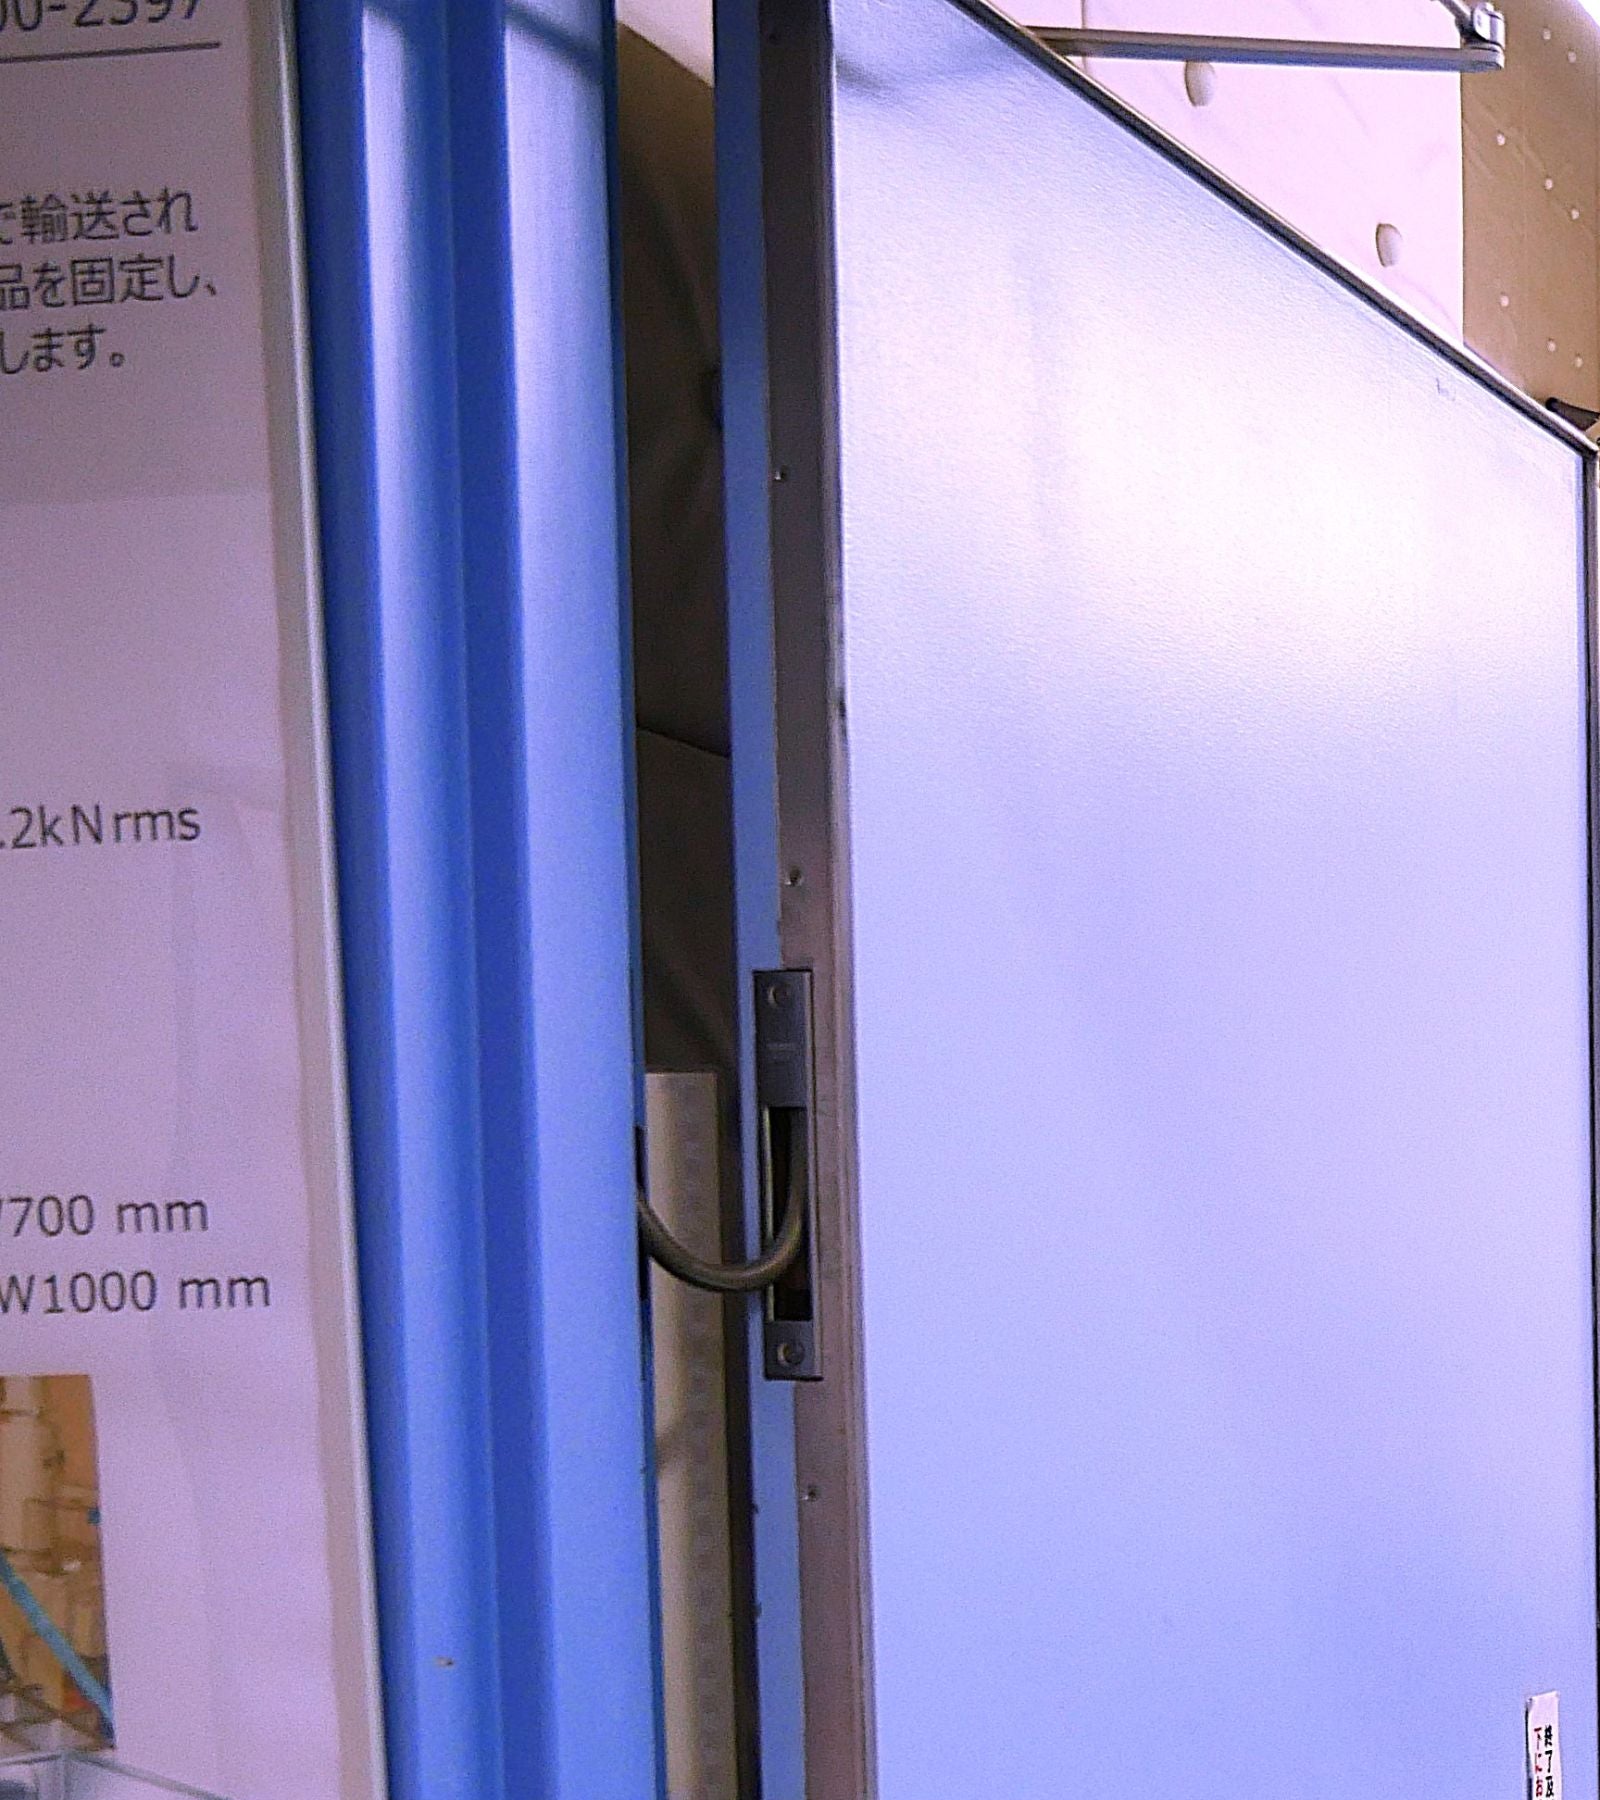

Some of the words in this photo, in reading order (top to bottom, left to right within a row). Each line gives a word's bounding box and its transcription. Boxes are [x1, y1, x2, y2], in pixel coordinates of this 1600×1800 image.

[0, 1195, 95, 1237] 700
[117, 1200, 208, 1233] mm
[0, 1270, 157, 1314] W1000
[180, 1276, 270, 1309] mm
